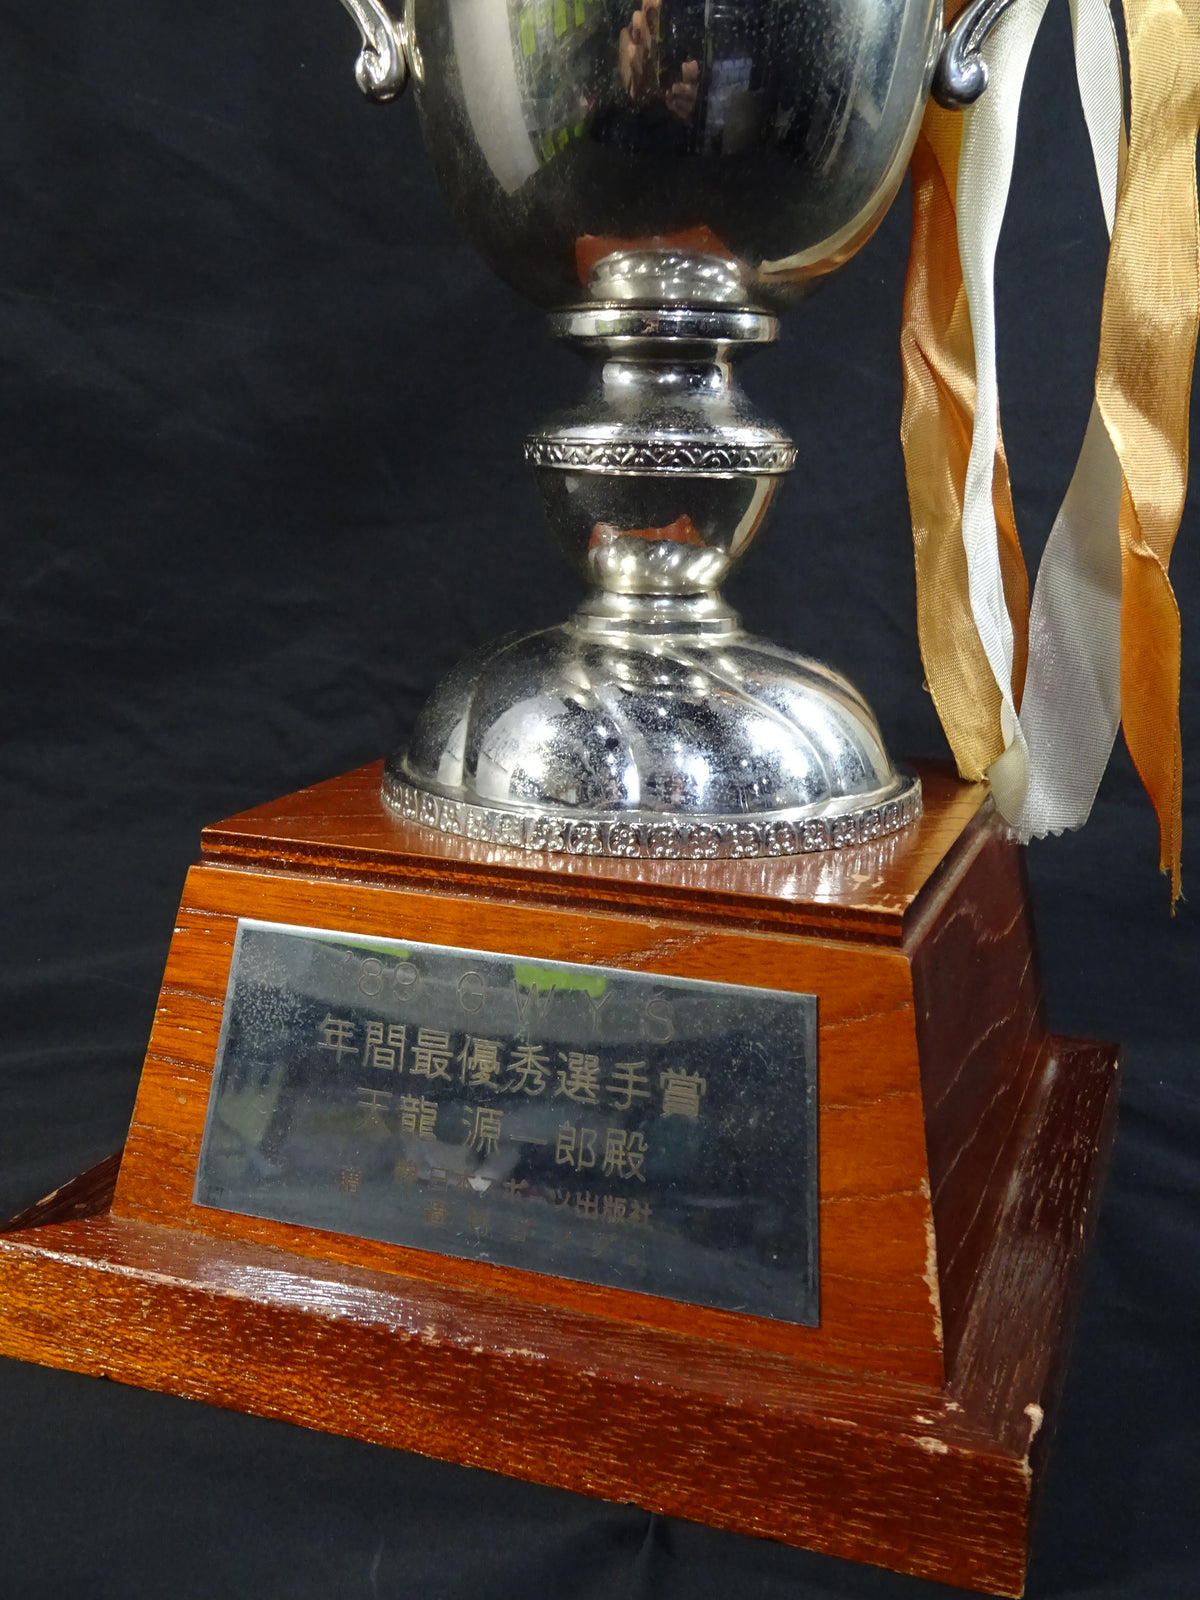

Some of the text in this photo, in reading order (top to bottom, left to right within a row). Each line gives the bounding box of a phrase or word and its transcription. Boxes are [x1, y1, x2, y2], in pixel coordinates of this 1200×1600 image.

[317, 1012, 707, 1119] 年間最優秀選手賞
